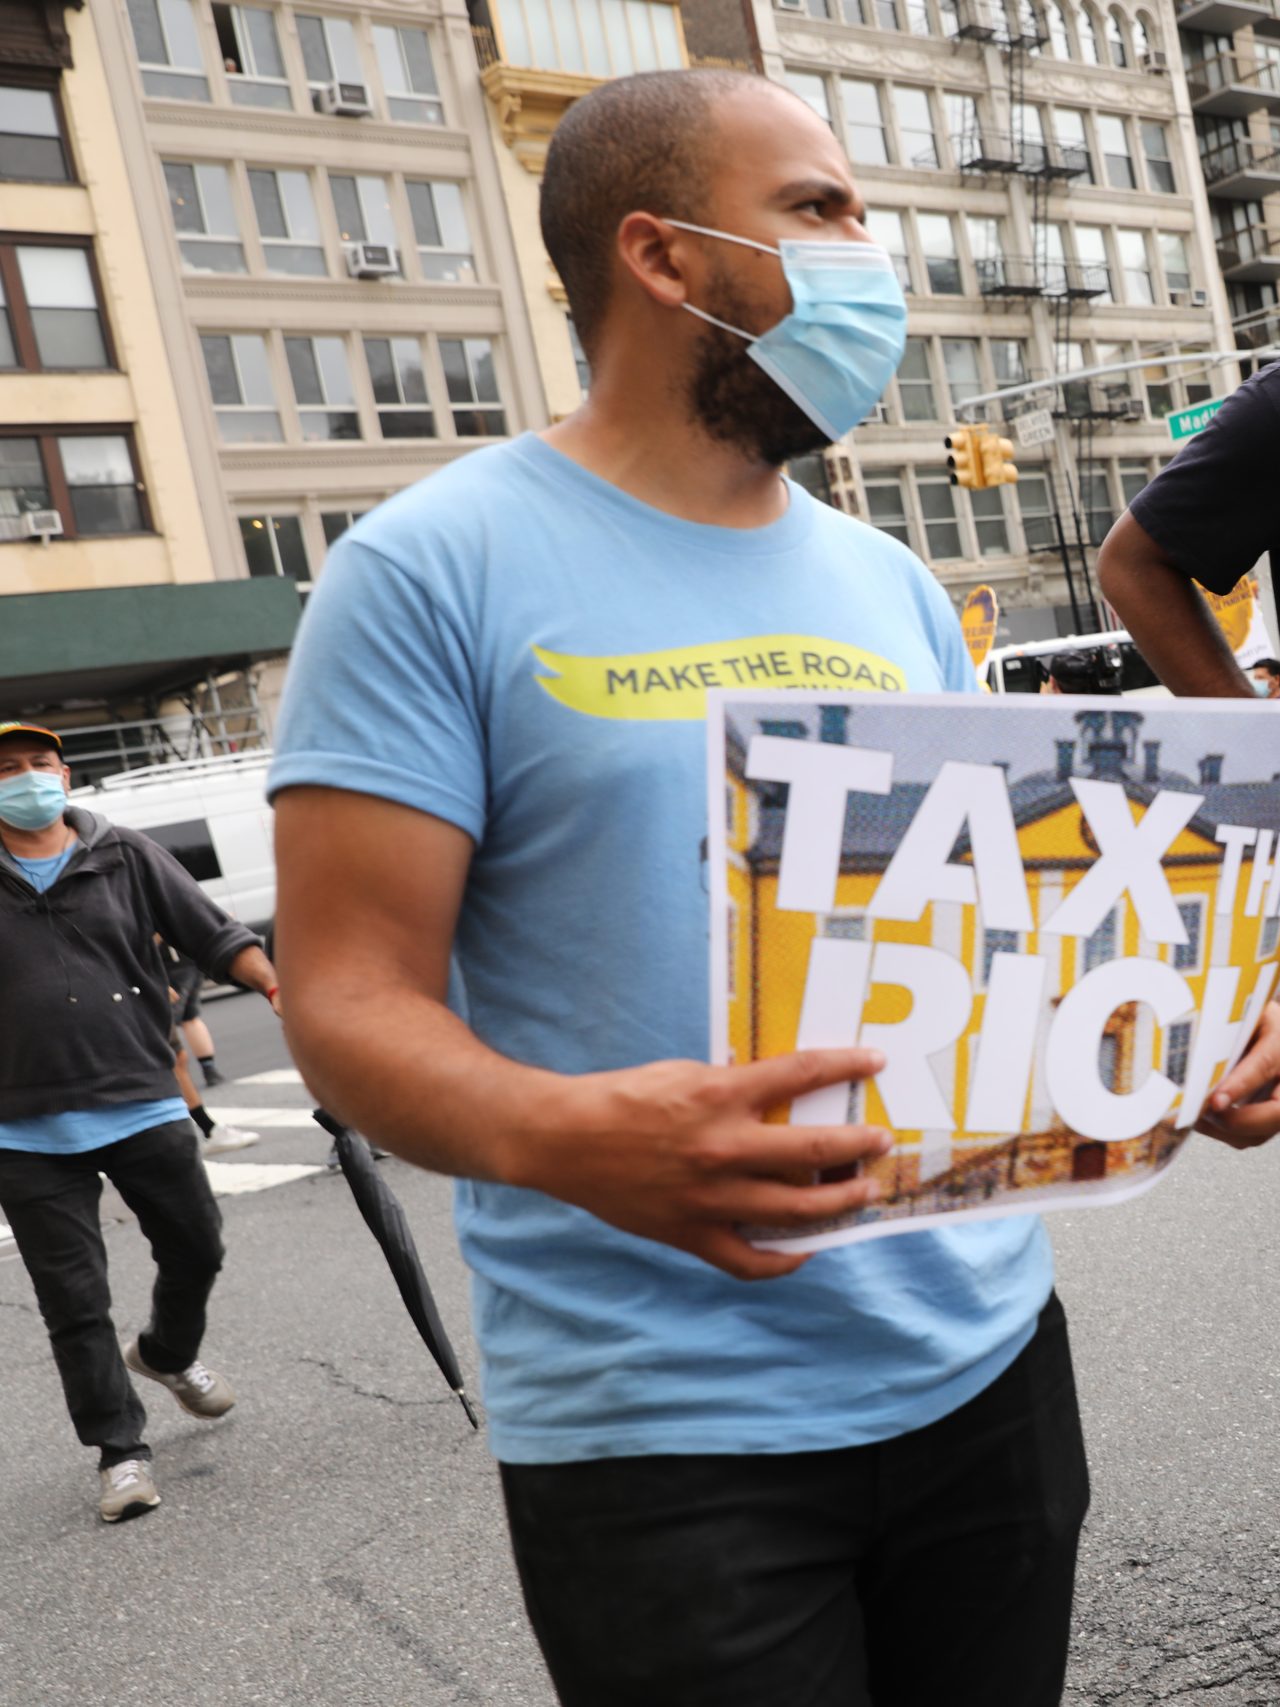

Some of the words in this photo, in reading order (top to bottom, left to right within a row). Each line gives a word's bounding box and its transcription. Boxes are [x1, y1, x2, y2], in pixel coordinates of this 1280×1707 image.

[605, 662, 721, 696] MAKE
[722, 650, 795, 683] THE
[801, 651, 902, 692] ROAD
[745, 734, 1205, 944] TAX
[788, 936, 1277, 1142] RICH
